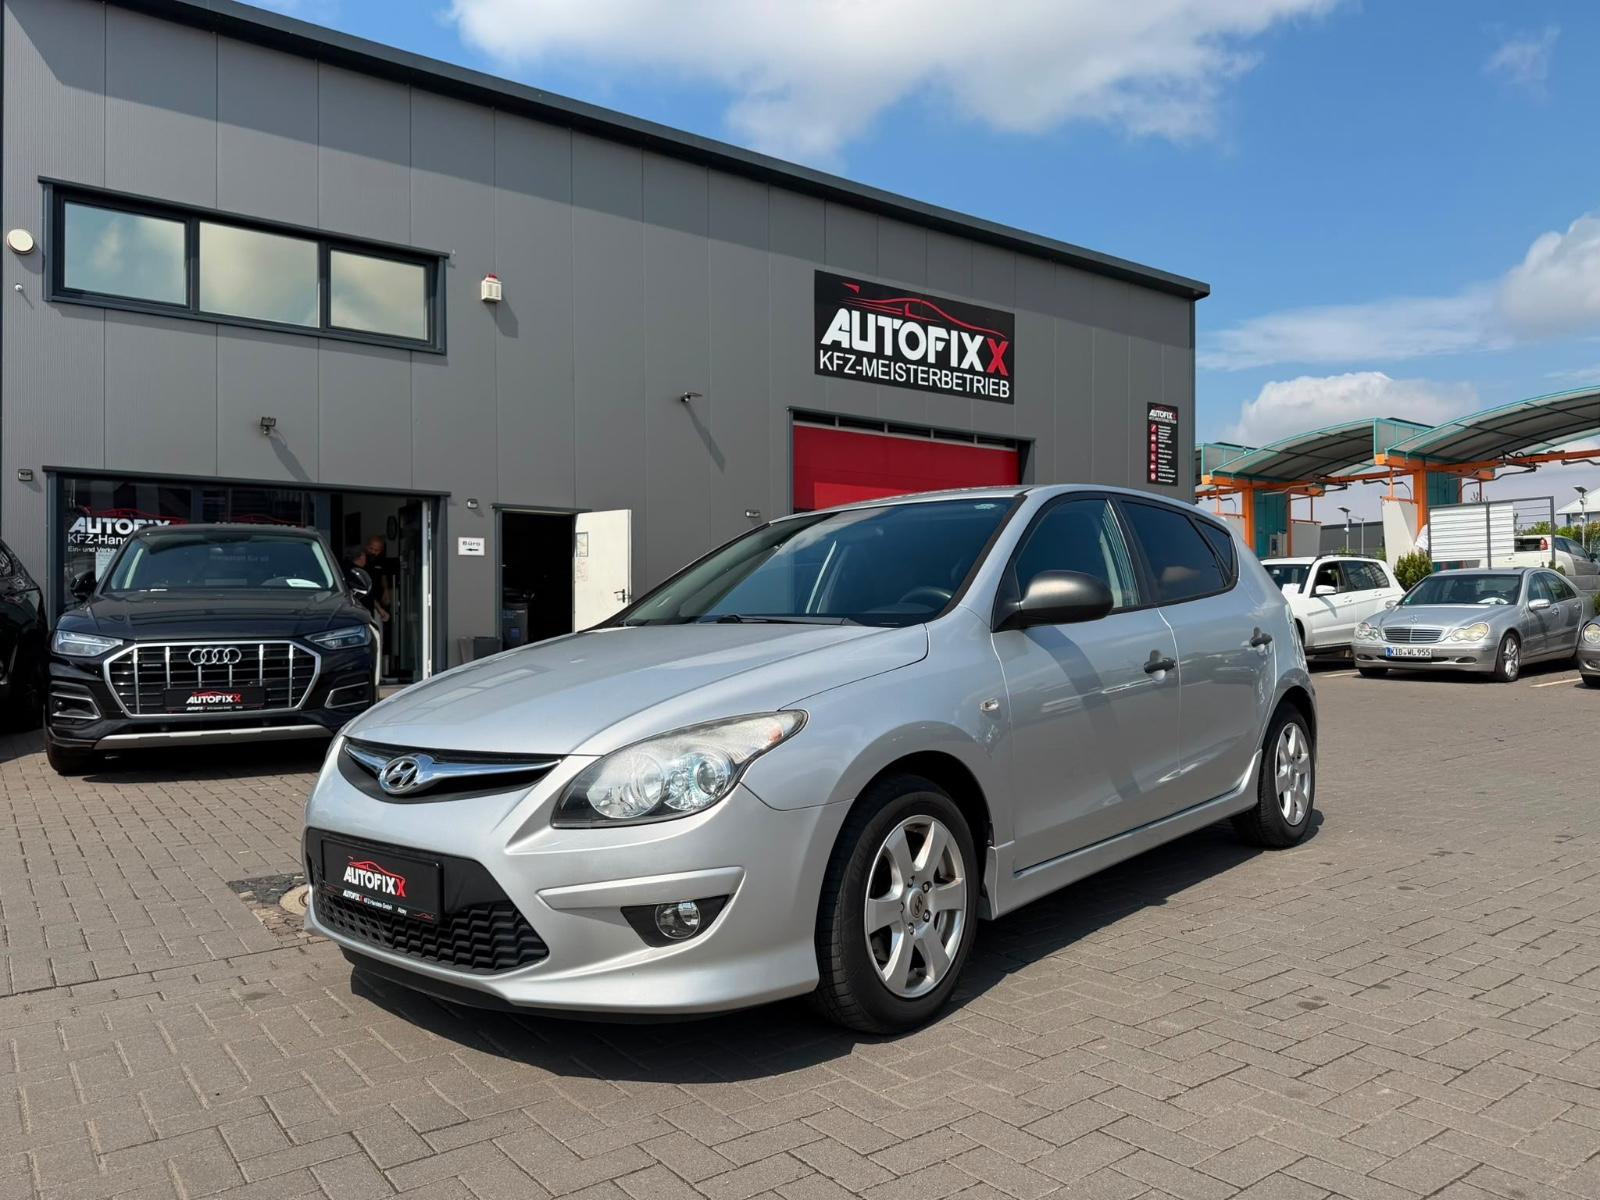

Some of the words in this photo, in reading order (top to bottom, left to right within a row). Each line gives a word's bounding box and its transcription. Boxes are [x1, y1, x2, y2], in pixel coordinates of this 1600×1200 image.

[820, 307, 1009, 377] AUTOFIXX
[819, 349, 1010, 398] KFZ-MEISTERBETRIEB
[186, 694, 241, 704] AUTOFIXX
[343, 865, 407, 897] AUTOFIXX
